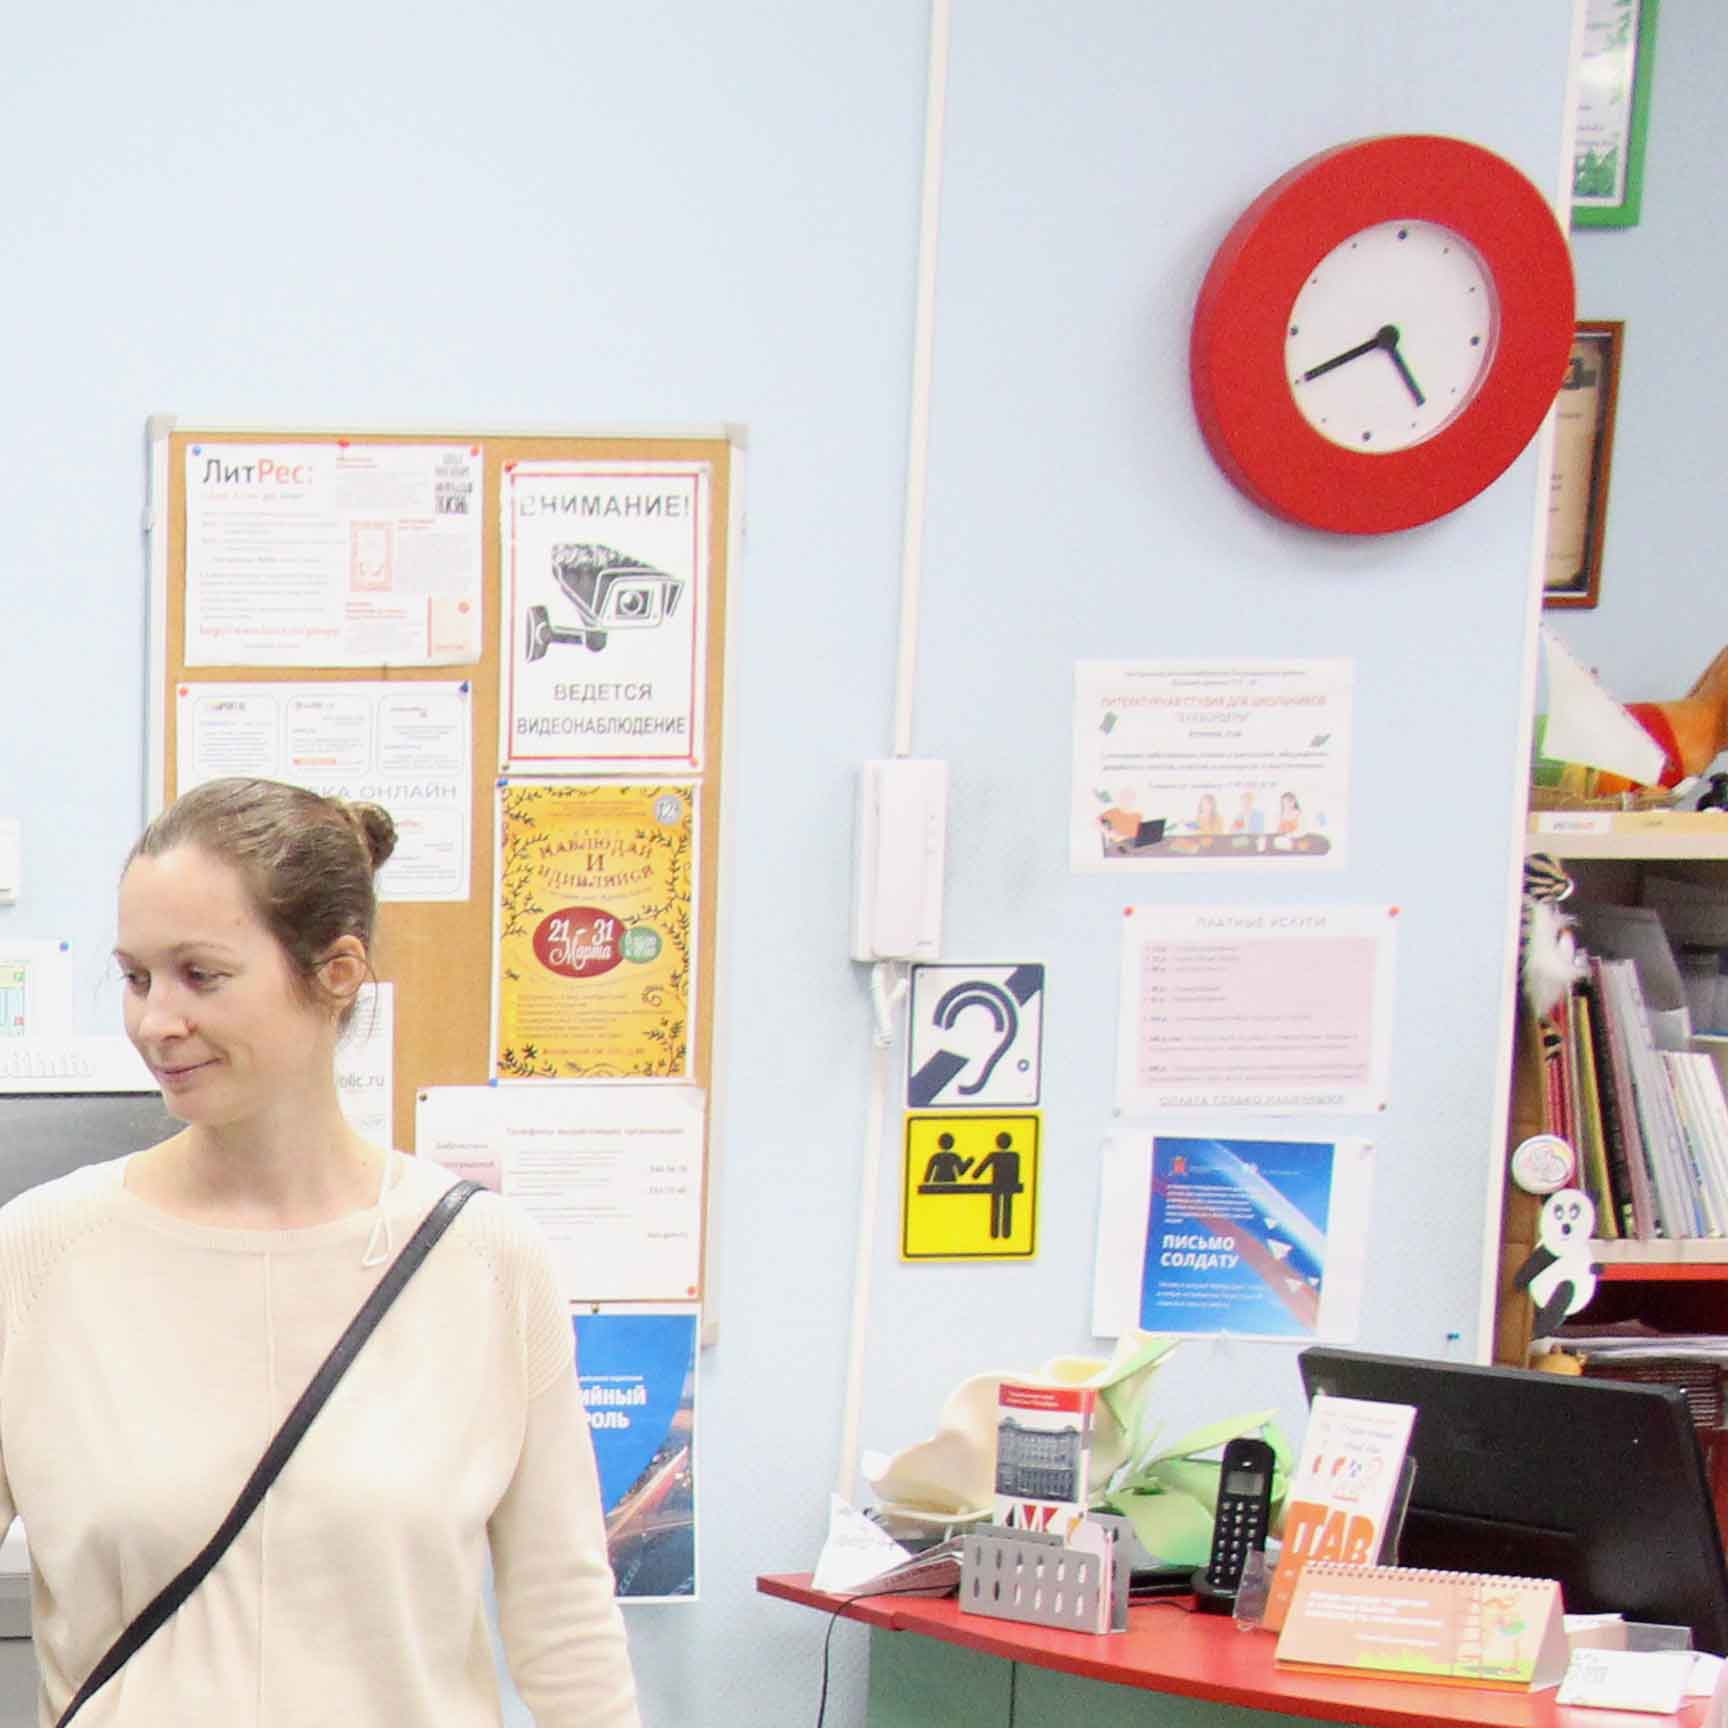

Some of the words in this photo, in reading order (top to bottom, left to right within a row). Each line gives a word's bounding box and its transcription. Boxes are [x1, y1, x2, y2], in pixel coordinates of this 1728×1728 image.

[202, 458, 314, 485] ЛитРес:
[520, 493, 690, 518] ВНИМАНИЕ!
[552, 682, 654, 703] ВЕДЕТСЯ
[516, 714, 686, 737] ВИДЕОНАБЛЮДЕНИЕ
[359, 781, 457, 800] ОНЛАЙН
[547, 918, 571, 943] 21
[591, 918, 615, 942] 31
[550, 930, 612, 969] Марта
[1161, 1234, 1237, 1251] ПИСЬМО
[1160, 1252, 1240, 1271] СОЛДАТУ
